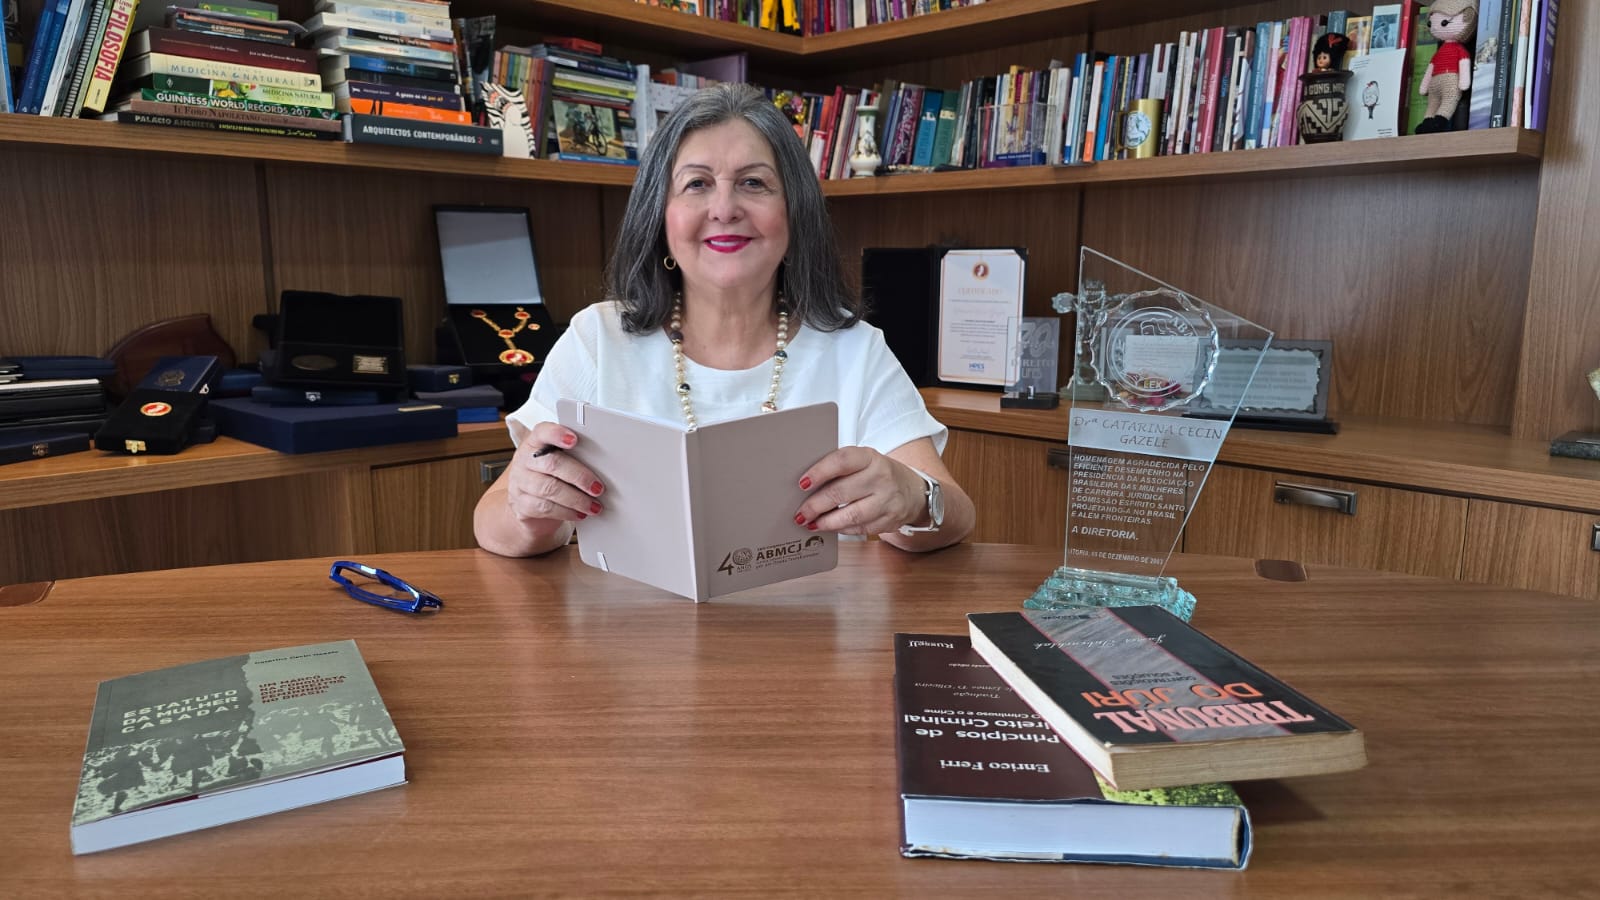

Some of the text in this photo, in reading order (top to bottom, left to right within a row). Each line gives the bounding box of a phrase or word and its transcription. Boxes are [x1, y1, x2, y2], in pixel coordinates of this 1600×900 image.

[94, 10, 130, 82] FILOSOFIA
[170, 64, 296, 86] MEDICINA NATURAL
[156, 92, 312, 117] GUINNESS WORLD RECORDS 2017
[362, 125, 411, 138] ARQUITECTOS
[1102, 419, 1174, 434] CATARINA
[1178, 426, 1222, 440] CECIN
[1120, 434, 1170, 448] GAZELE
[1073, 463, 1114, 472] EFICIENTE
[1114, 466, 1170, 477] DESEMPENHO
[1074, 455, 1204, 472] HOMENAGEM AGRADECIDA PELO
[1072, 479, 1118, 488] BRASILEIRA
[1138, 485, 1184, 495] MULHERES
[1084, 488, 1124, 498] CARREIRA
[1147, 510, 1176, 519] BRASIL
[1072, 526, 1138, 540] A DIRETORIA.
[756, 544, 802, 560] ABMCJ
[280, 675, 320, 684] MARCO
[280, 676, 346, 688] CONQUISTA
[288, 680, 344, 690] DIREITOS
[261, 686, 329, 699] FEMININOS
[1081, 682, 1264, 708] DO JÚRI
[124, 689, 238, 718] ESTATUTO
[122, 696, 238, 726] DA MULHER
[976, 711, 1028, 719] Criminoso
[1093, 700, 1316, 734] TRIBUNAL
[904, 714, 1051, 730] ireito Criminal
[915, 728, 943, 737] de
[939, 759, 1050, 772] Enrico Ferri
